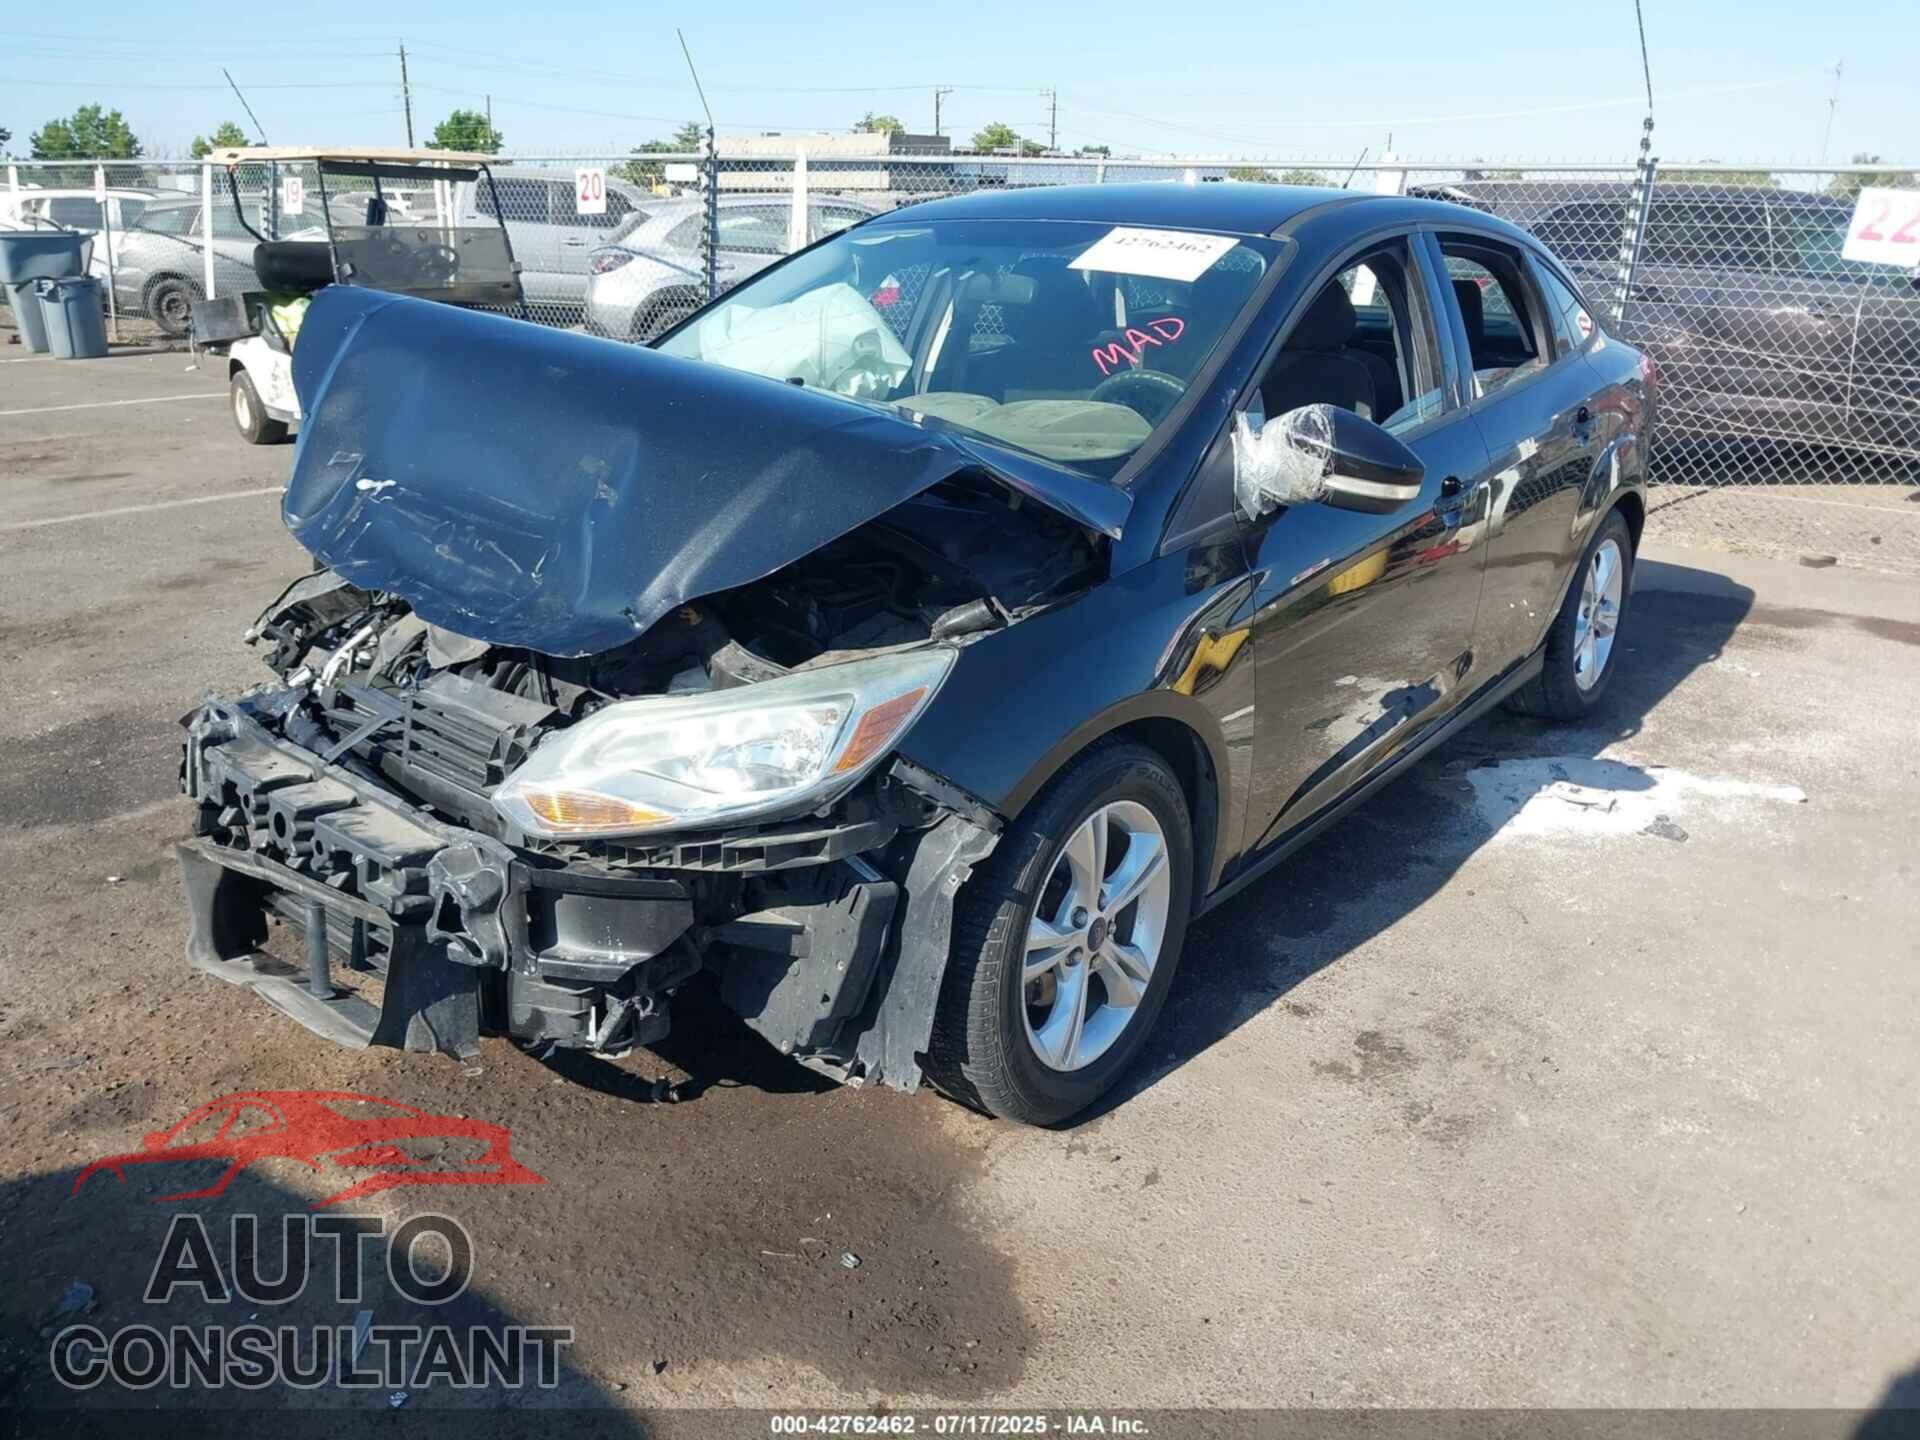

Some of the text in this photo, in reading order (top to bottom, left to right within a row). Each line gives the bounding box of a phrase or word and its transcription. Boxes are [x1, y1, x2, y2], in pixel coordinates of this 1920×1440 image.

[285, 180, 300, 203] 19
[579, 172, 601, 201] 20
[1855, 198, 1920, 243] 22
[1092, 317, 1185, 376] MAD
